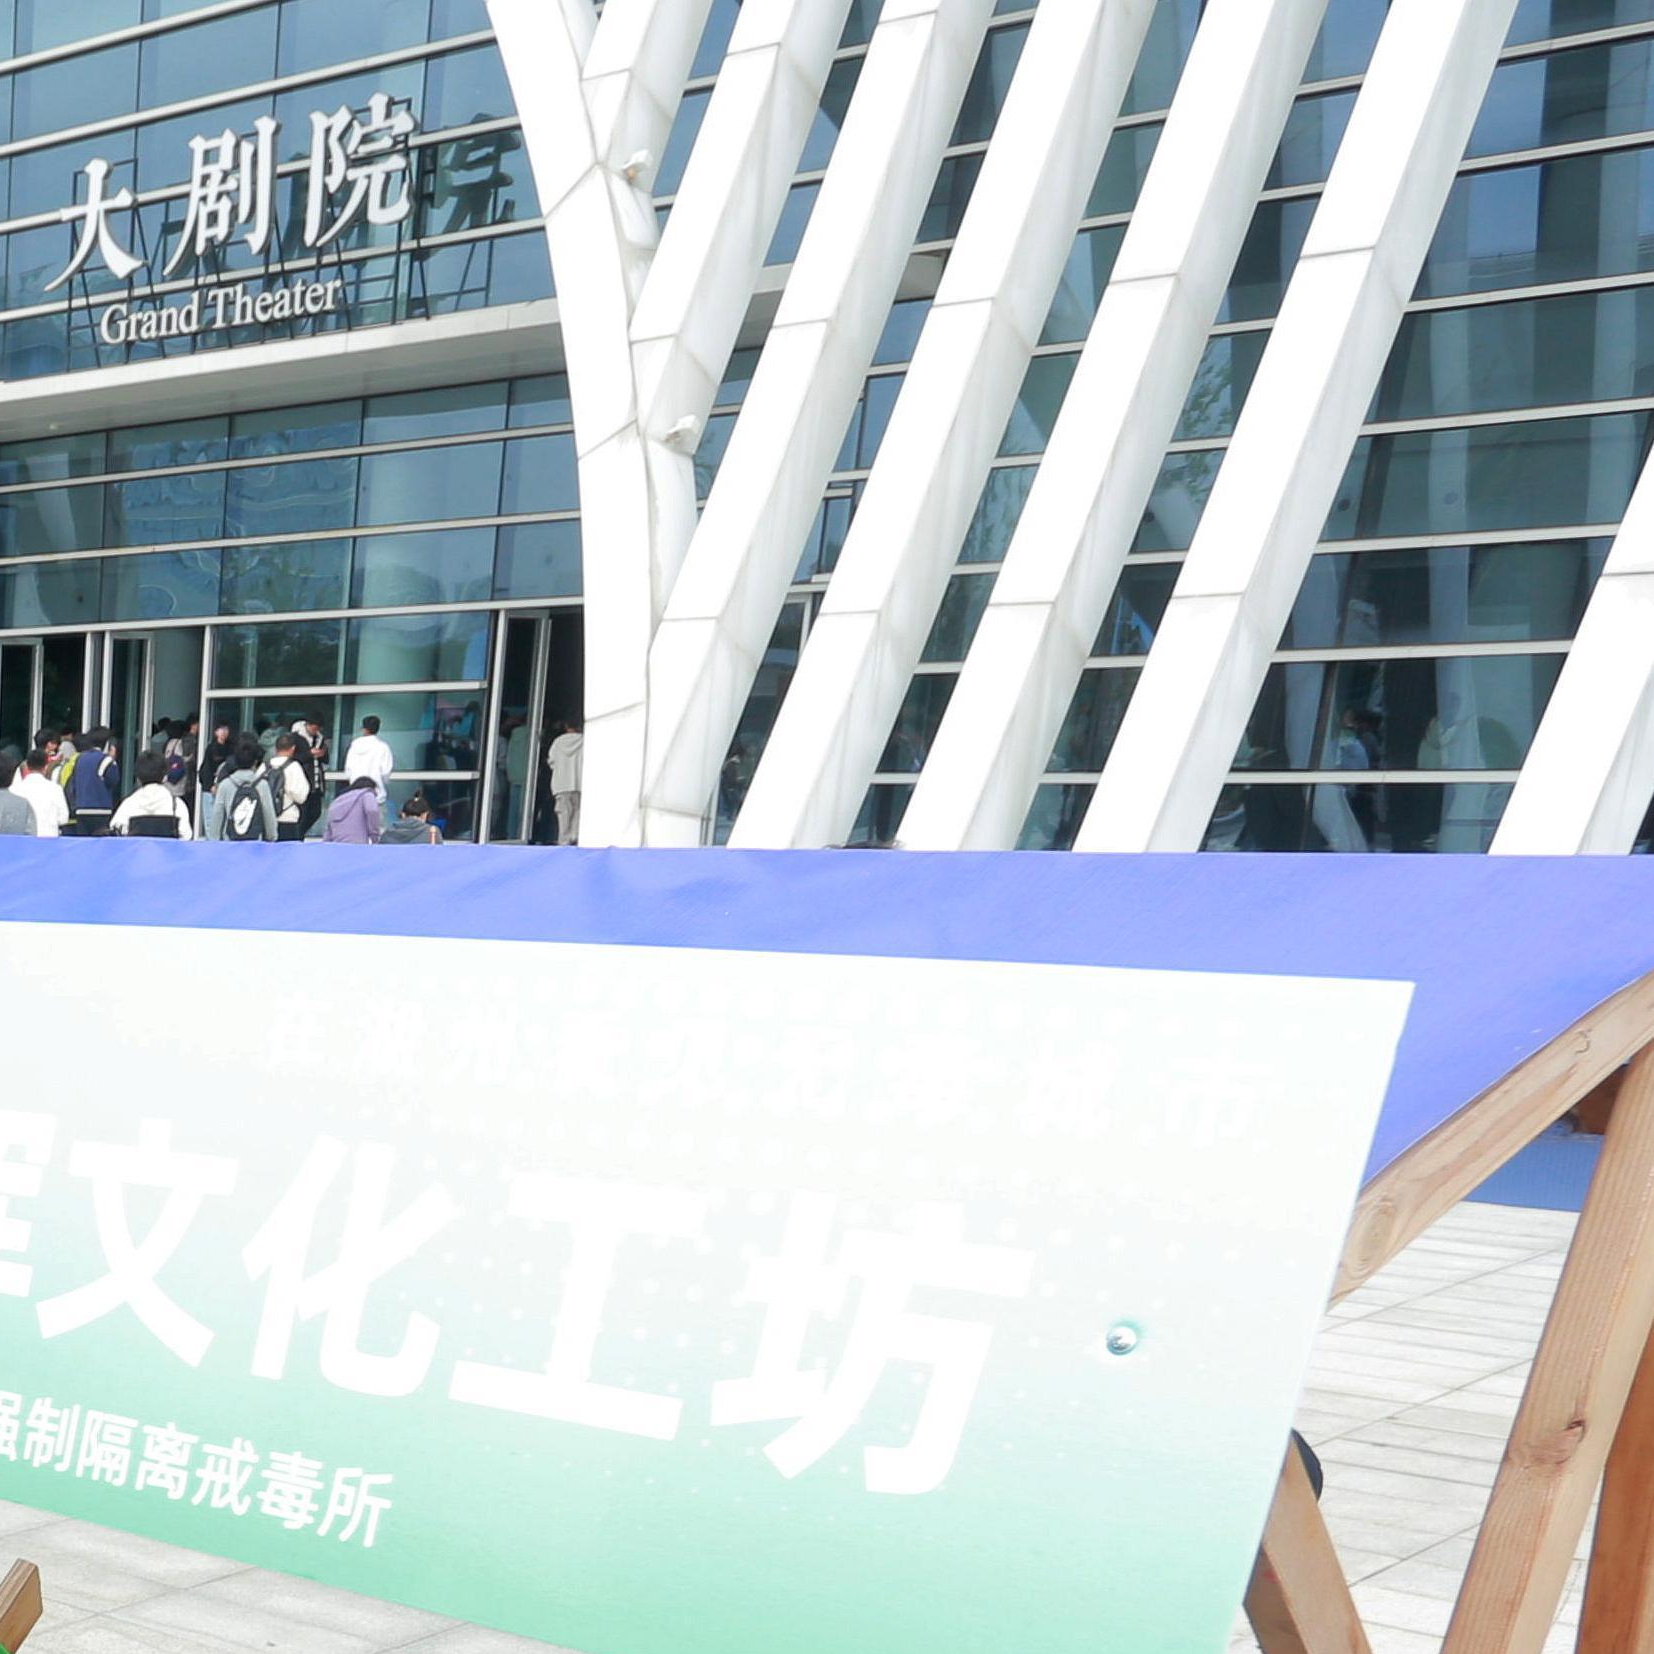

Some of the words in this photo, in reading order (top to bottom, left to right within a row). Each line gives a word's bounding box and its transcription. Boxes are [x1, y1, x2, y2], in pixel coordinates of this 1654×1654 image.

[44, 90, 419, 292] 大剧院
[100, 289, 199, 344] Grand
[211, 275, 344, 326] Theater
